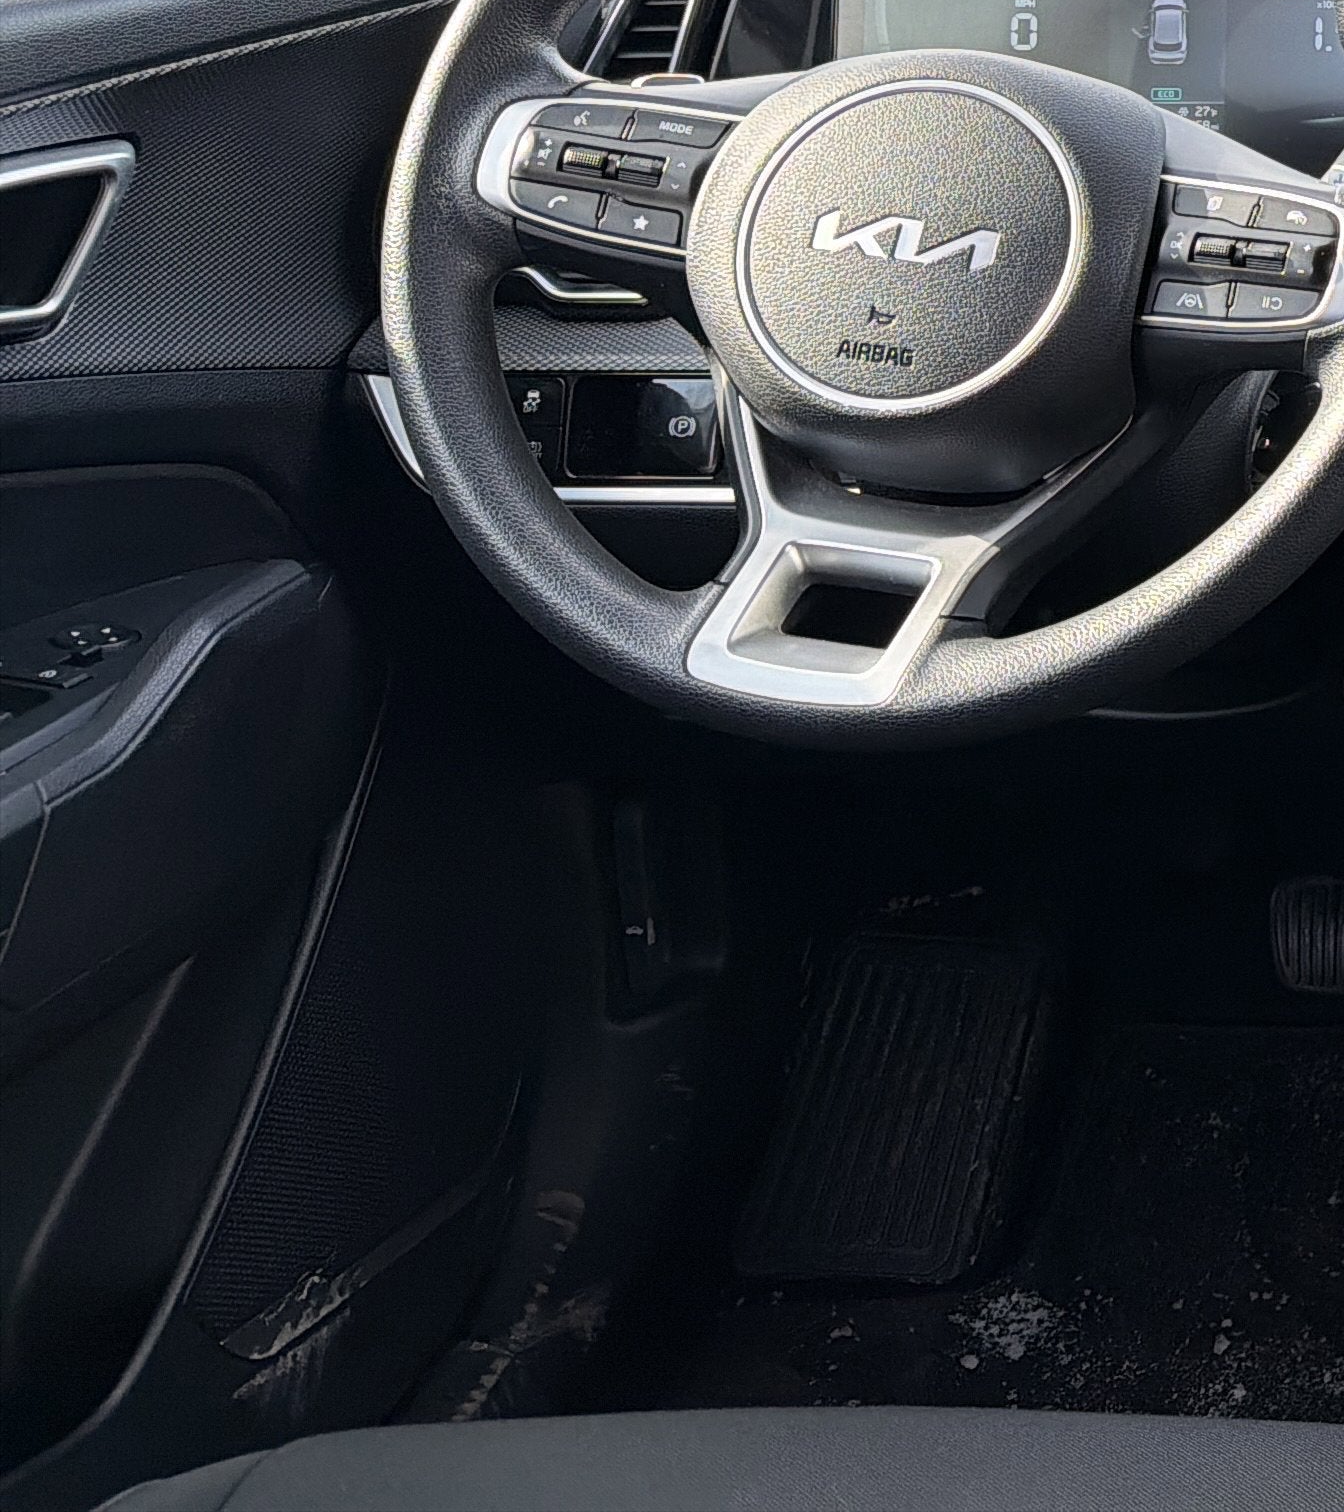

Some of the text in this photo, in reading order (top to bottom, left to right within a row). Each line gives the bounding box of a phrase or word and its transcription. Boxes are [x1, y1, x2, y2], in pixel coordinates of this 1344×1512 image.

[1015, 0, 1036, 8] MPH
[1010, 12, 1039, 51] 0
[1157, 90, 1175, 98] ECO
[658, 120, 694, 136] MODE
[812, 207, 1001, 272] KIA
[836, 340, 915, 367] AIRBAG
